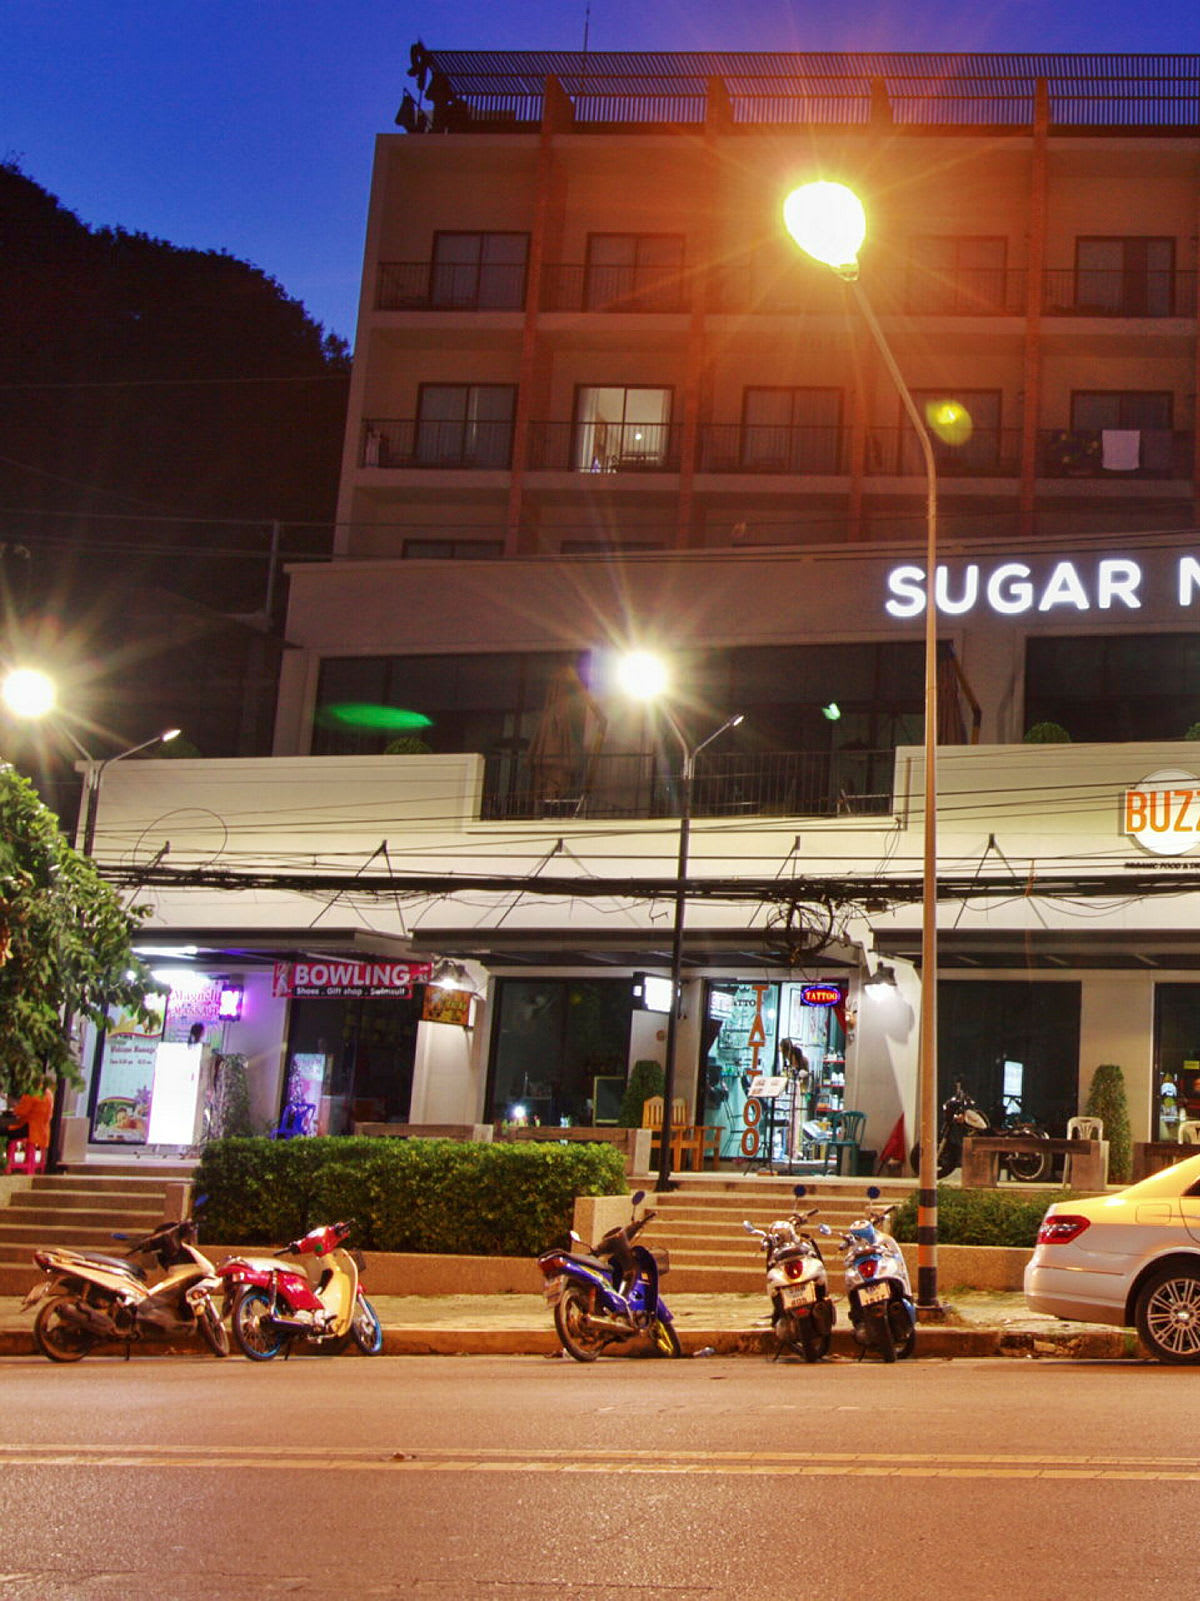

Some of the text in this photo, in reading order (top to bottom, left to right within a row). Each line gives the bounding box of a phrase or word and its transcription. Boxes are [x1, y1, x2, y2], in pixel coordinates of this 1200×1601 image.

[886, 560, 1142, 617] SUGAR
[294, 964, 411, 986] BOWLING
[326, 988, 341, 996] Gift
[343, 988, 362, 997] shop
[369, 987, 405, 996] Swimsuit
[805, 992, 838, 1001] TATTOO
